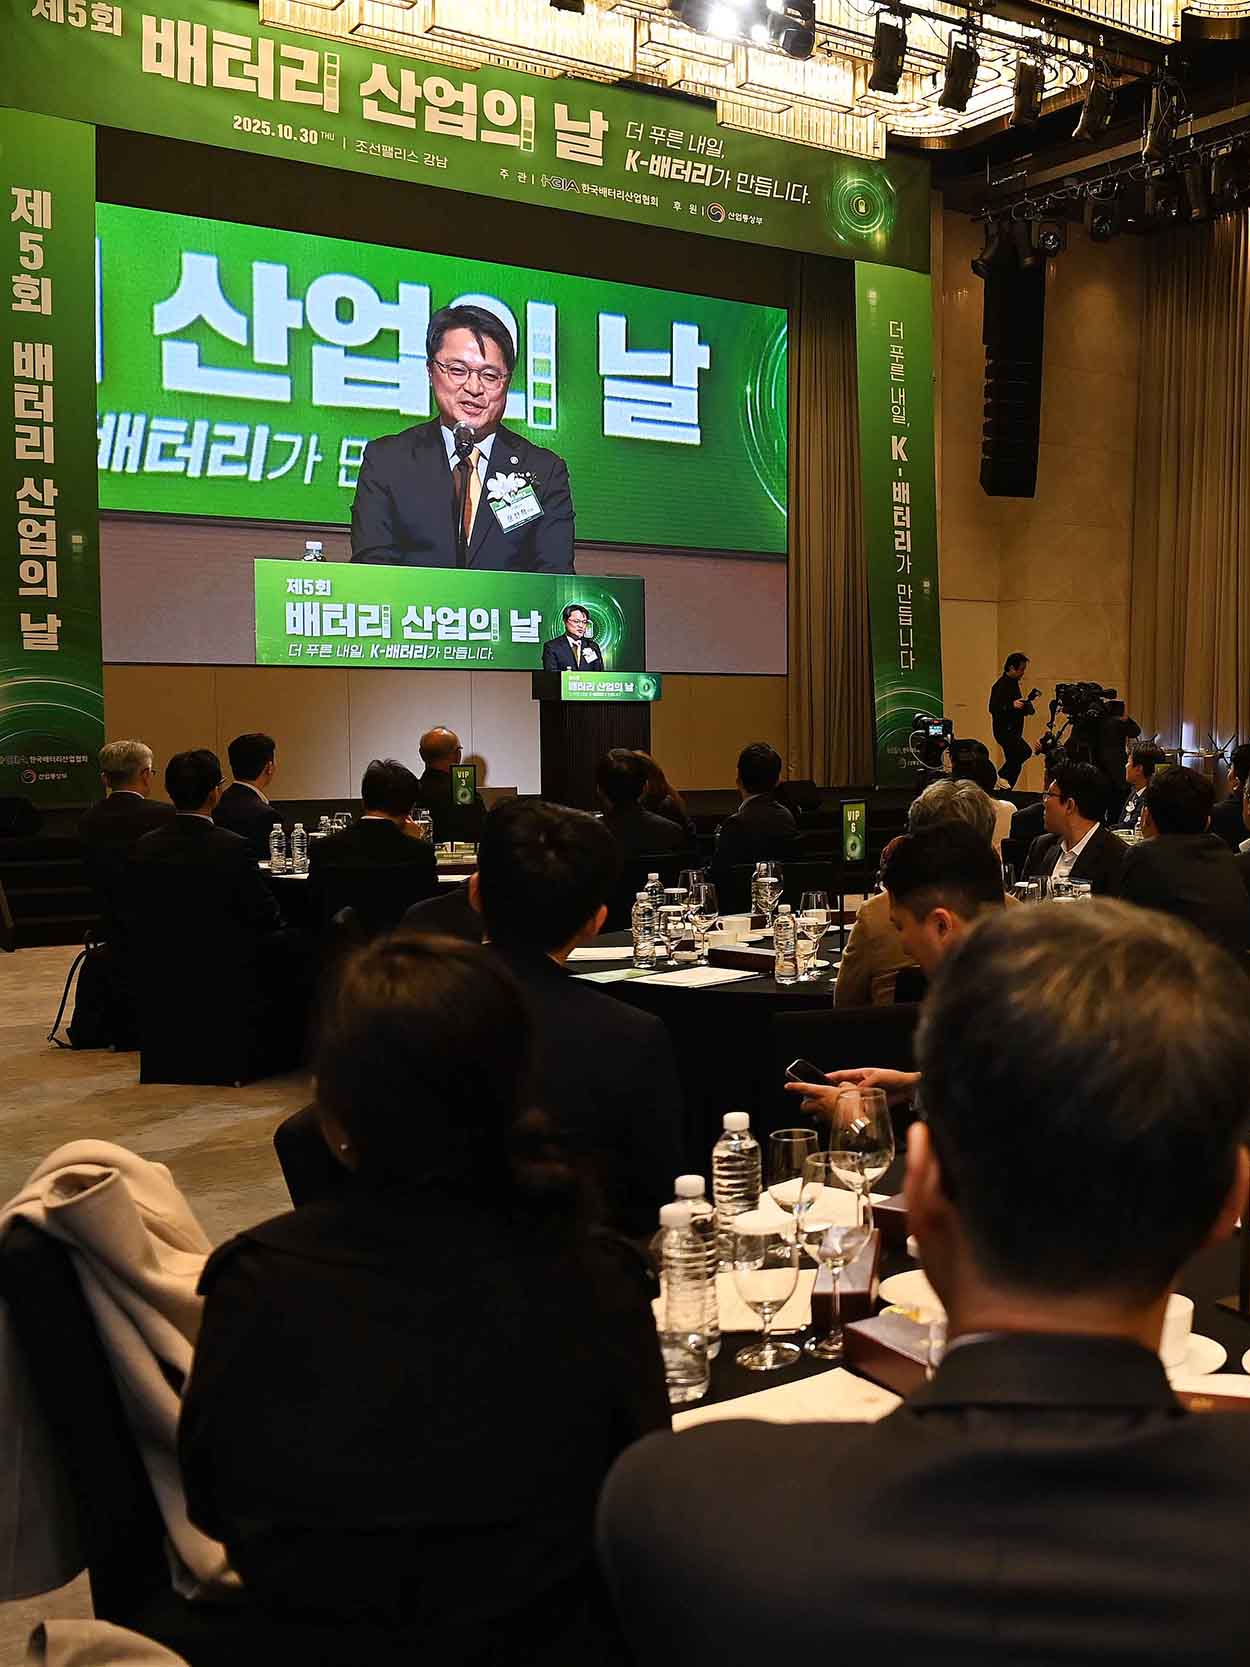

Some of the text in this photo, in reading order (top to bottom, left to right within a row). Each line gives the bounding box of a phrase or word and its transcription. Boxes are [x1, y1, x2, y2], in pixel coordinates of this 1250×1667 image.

[141, 14, 609, 167] 배터리 산업의 날
[232, 115, 449, 169] 2025.10.30 THU 조선팰리스 강남
[625, 121, 726, 160] 더 푸른 내일,
[580, 183, 660, 208] 한국배터리산업협회
[625, 149, 812, 205] K-배터리가 만듭니다.
[598, 311, 711, 446] 날
[11, 186, 62, 651] 제5회 배터리 산업의 날
[889, 320, 916, 676] 더 푸른 내일, K-배터리가 만듭니다.
[286, 577, 332, 596] 제5회
[285, 601, 543, 644] 배터리 산업의 날
[288, 644, 302, 658] 더
[305, 644, 332, 659] 푸른
[370, 644, 441, 660] K-배터리가
[443, 646, 495, 661] 만듭니다.
[457, 770, 470, 779] VIP
[847, 810, 860, 821] VIP
[850, 822, 856, 833] 6
